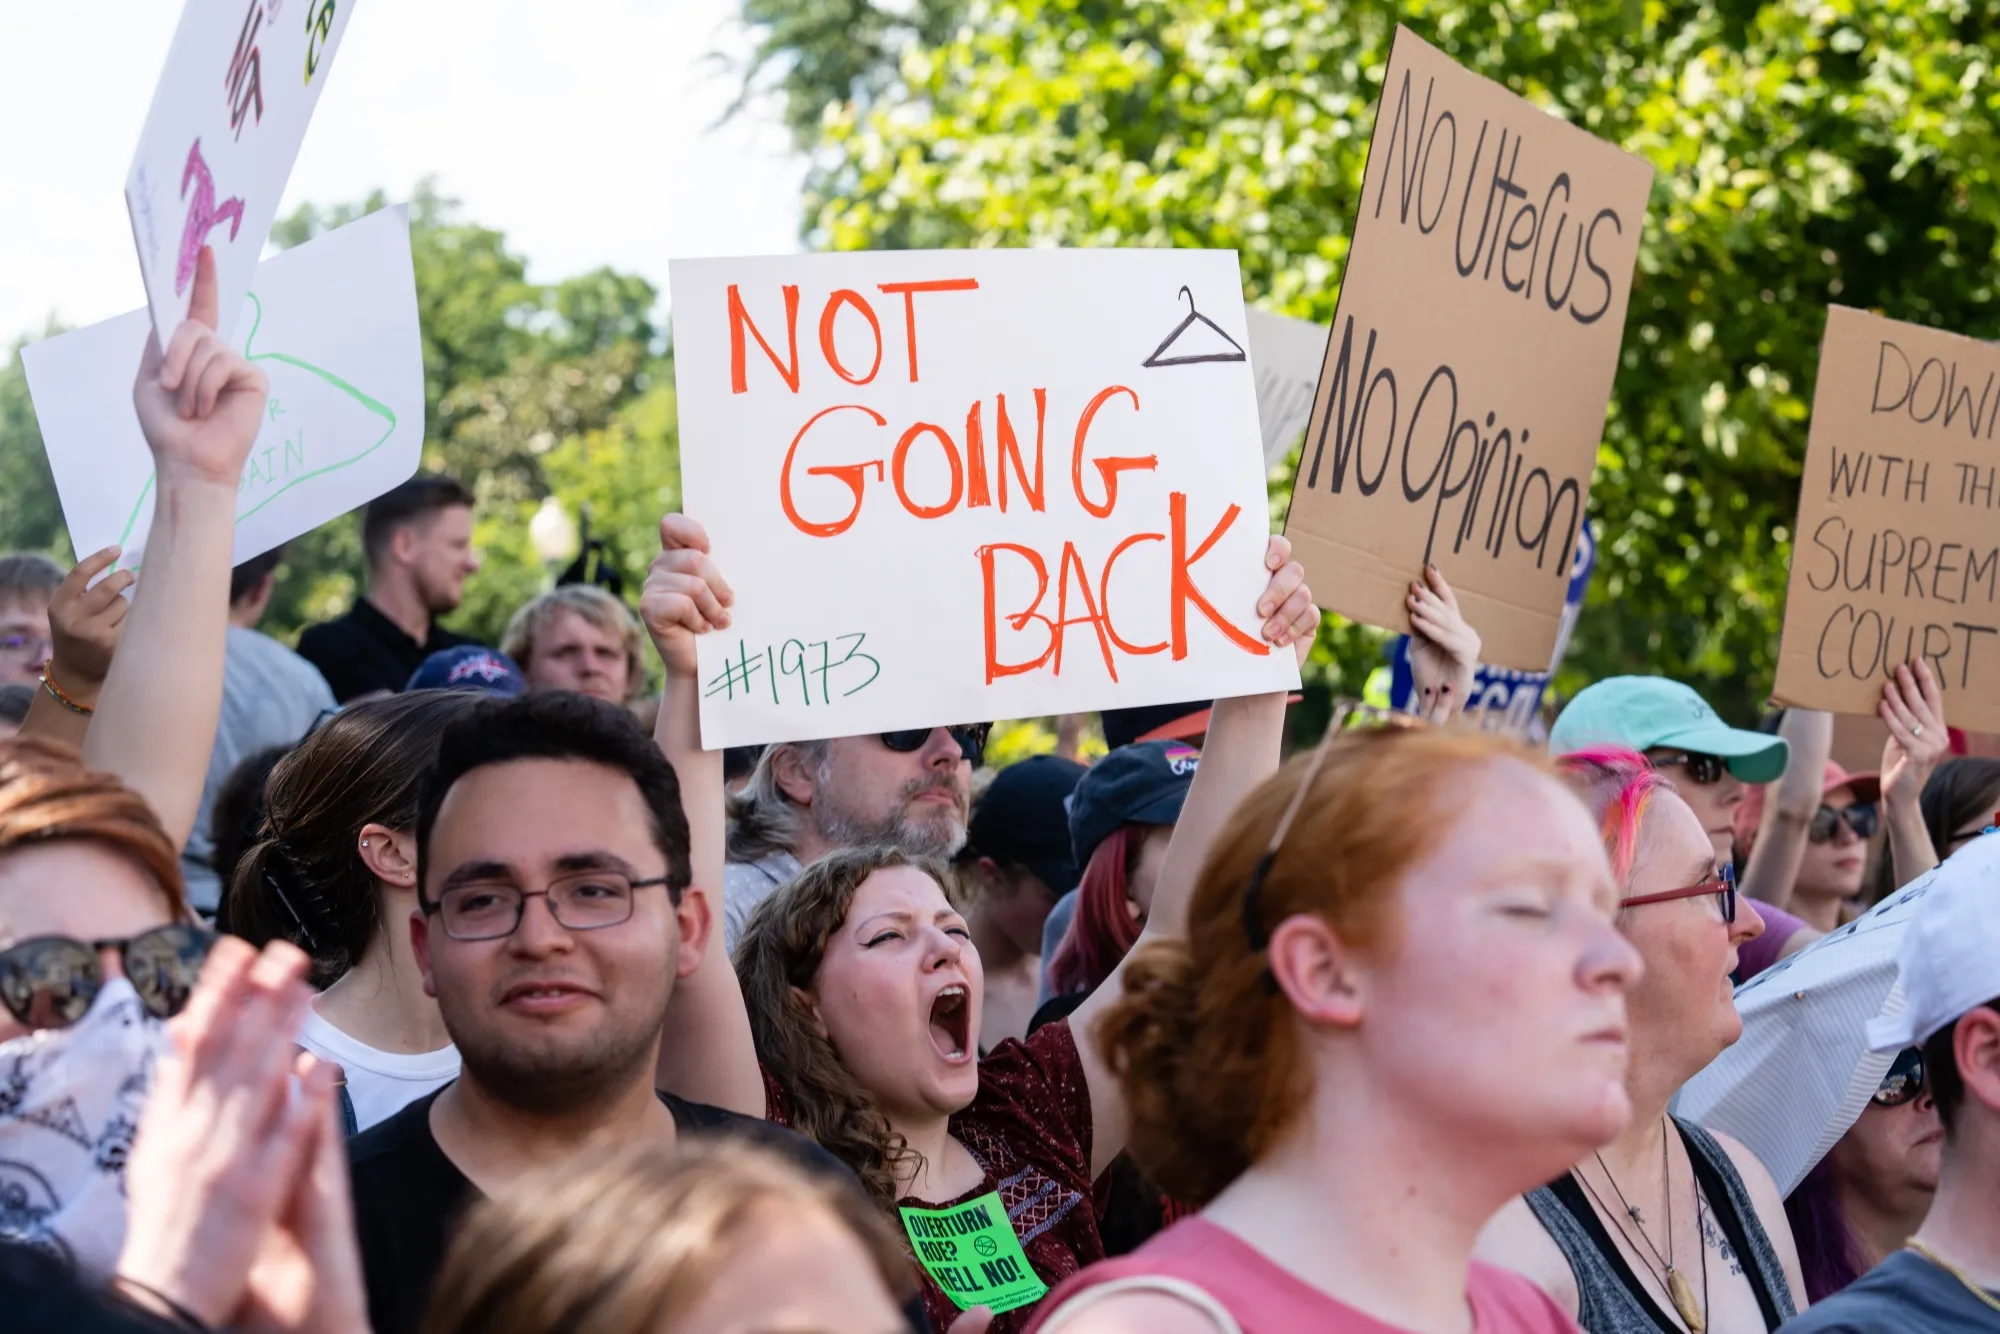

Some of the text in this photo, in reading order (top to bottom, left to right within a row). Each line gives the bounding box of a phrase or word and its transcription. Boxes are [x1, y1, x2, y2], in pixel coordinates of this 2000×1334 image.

[727, 278, 979, 394] NOT
[779, 385, 1158, 538] GOING
[1308, 314, 1398, 497] No
[1401, 365, 1581, 578] Opinion
[1830, 446, 2000, 509] WITH TH
[974, 491, 1270, 686] BACK
[1807, 516, 1999, 604] SUPREM
[705, 632, 881, 706] #1973
[1817, 602, 1999, 690] COURT
[908, 1204, 993, 1238] OVERTURN
[918, 1240, 958, 1263] ROE?
[932, 1255, 1026, 1293] HELL NO!
